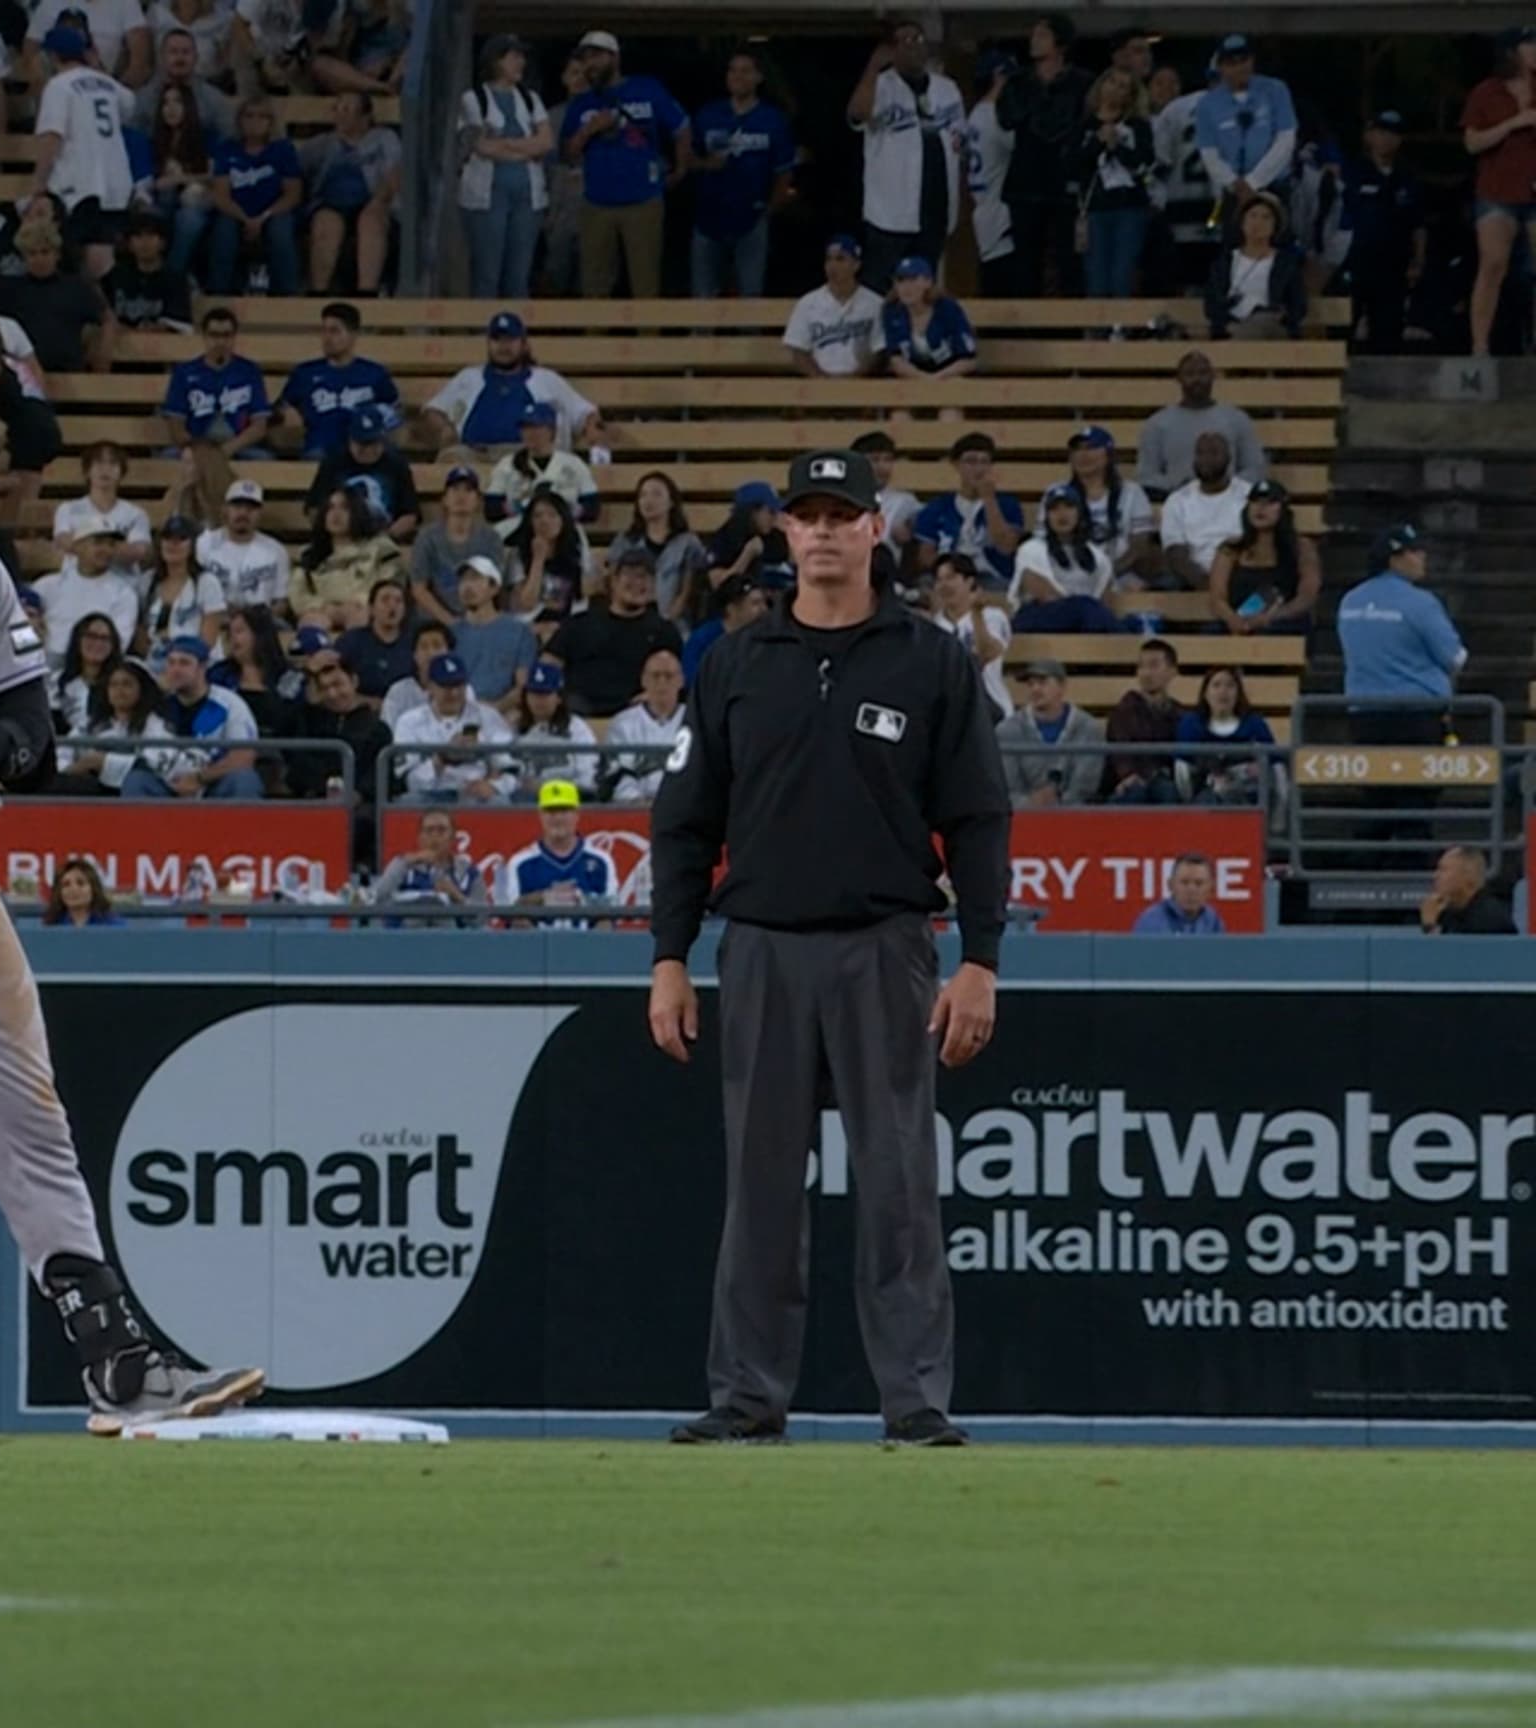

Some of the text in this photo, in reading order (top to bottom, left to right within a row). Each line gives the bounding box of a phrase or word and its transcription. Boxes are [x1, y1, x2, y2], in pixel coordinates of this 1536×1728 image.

[95, 97, 114, 138] 5
[1324, 754, 1369, 779] 310
[804, 1089, 1536, 1201] artwater
[127, 1134, 473, 1229] smart
[320, 1235, 472, 1279] water
[947, 1209, 1510, 1289] alkaline 9.5+pH
[1143, 1288, 1510, 1331] with antioxidant
